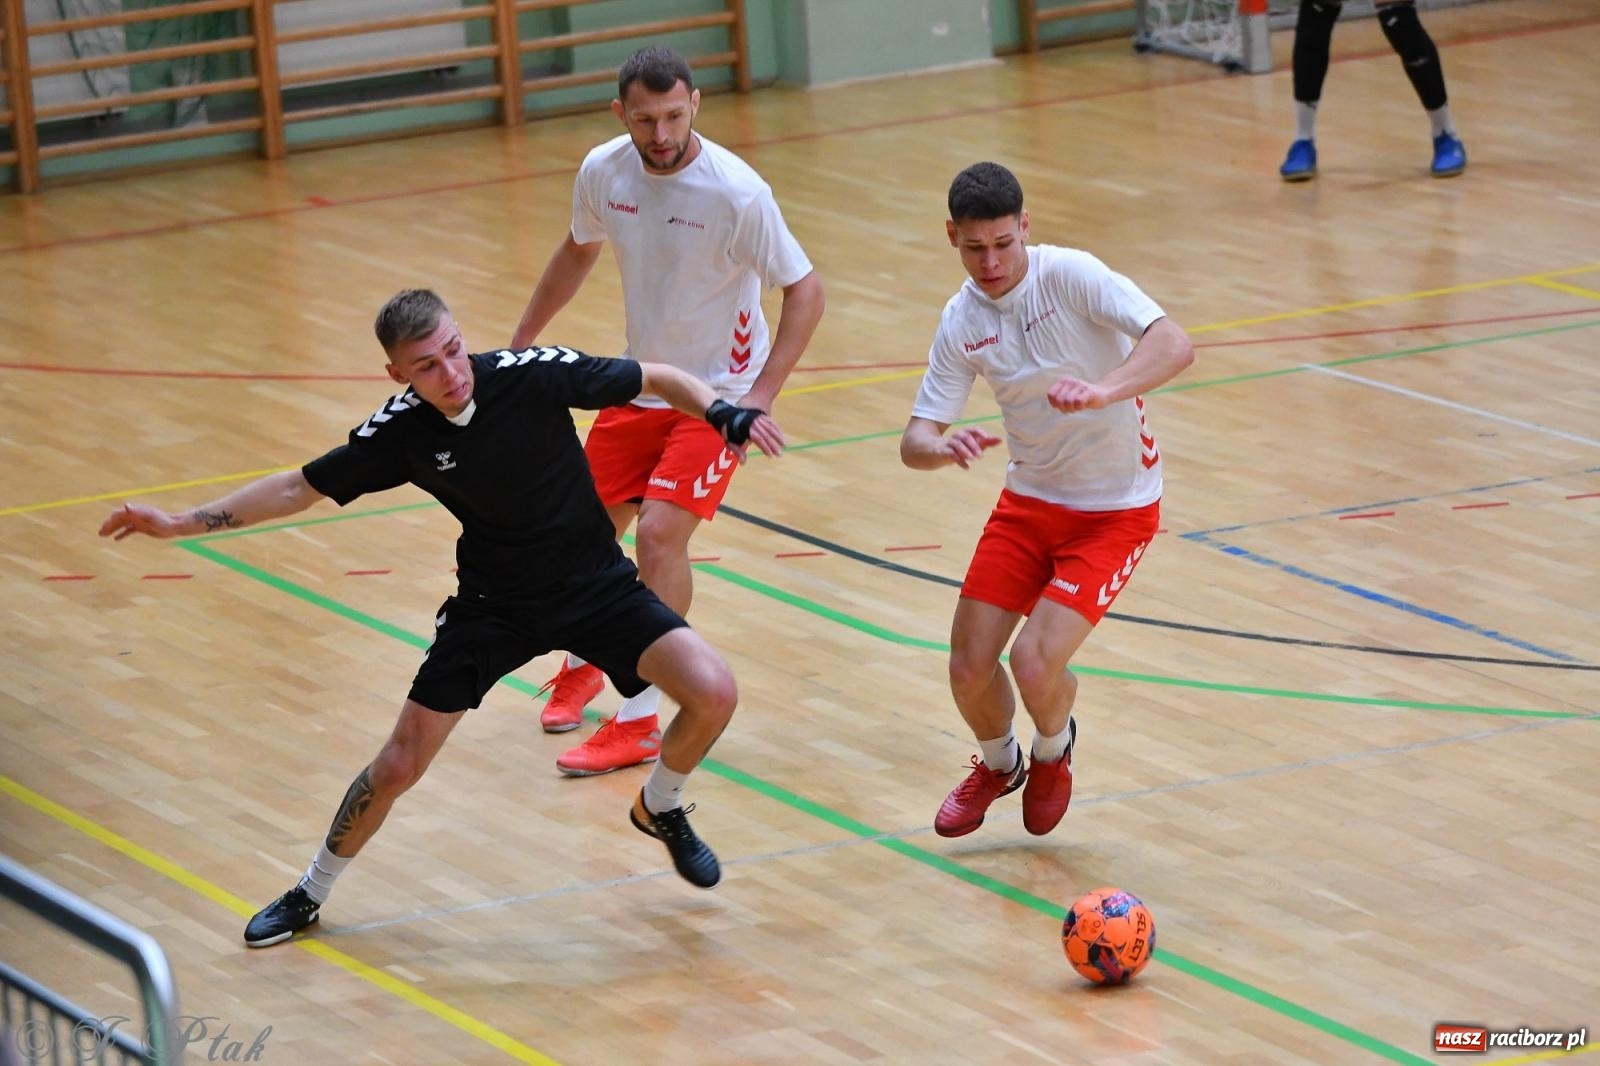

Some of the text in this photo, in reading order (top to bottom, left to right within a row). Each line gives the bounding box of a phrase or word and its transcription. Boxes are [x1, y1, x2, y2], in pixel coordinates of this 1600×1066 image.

[608, 200, 639, 215] hummel
[964, 333, 999, 353] hummel
[1128, 911, 1147, 962] SELECT
